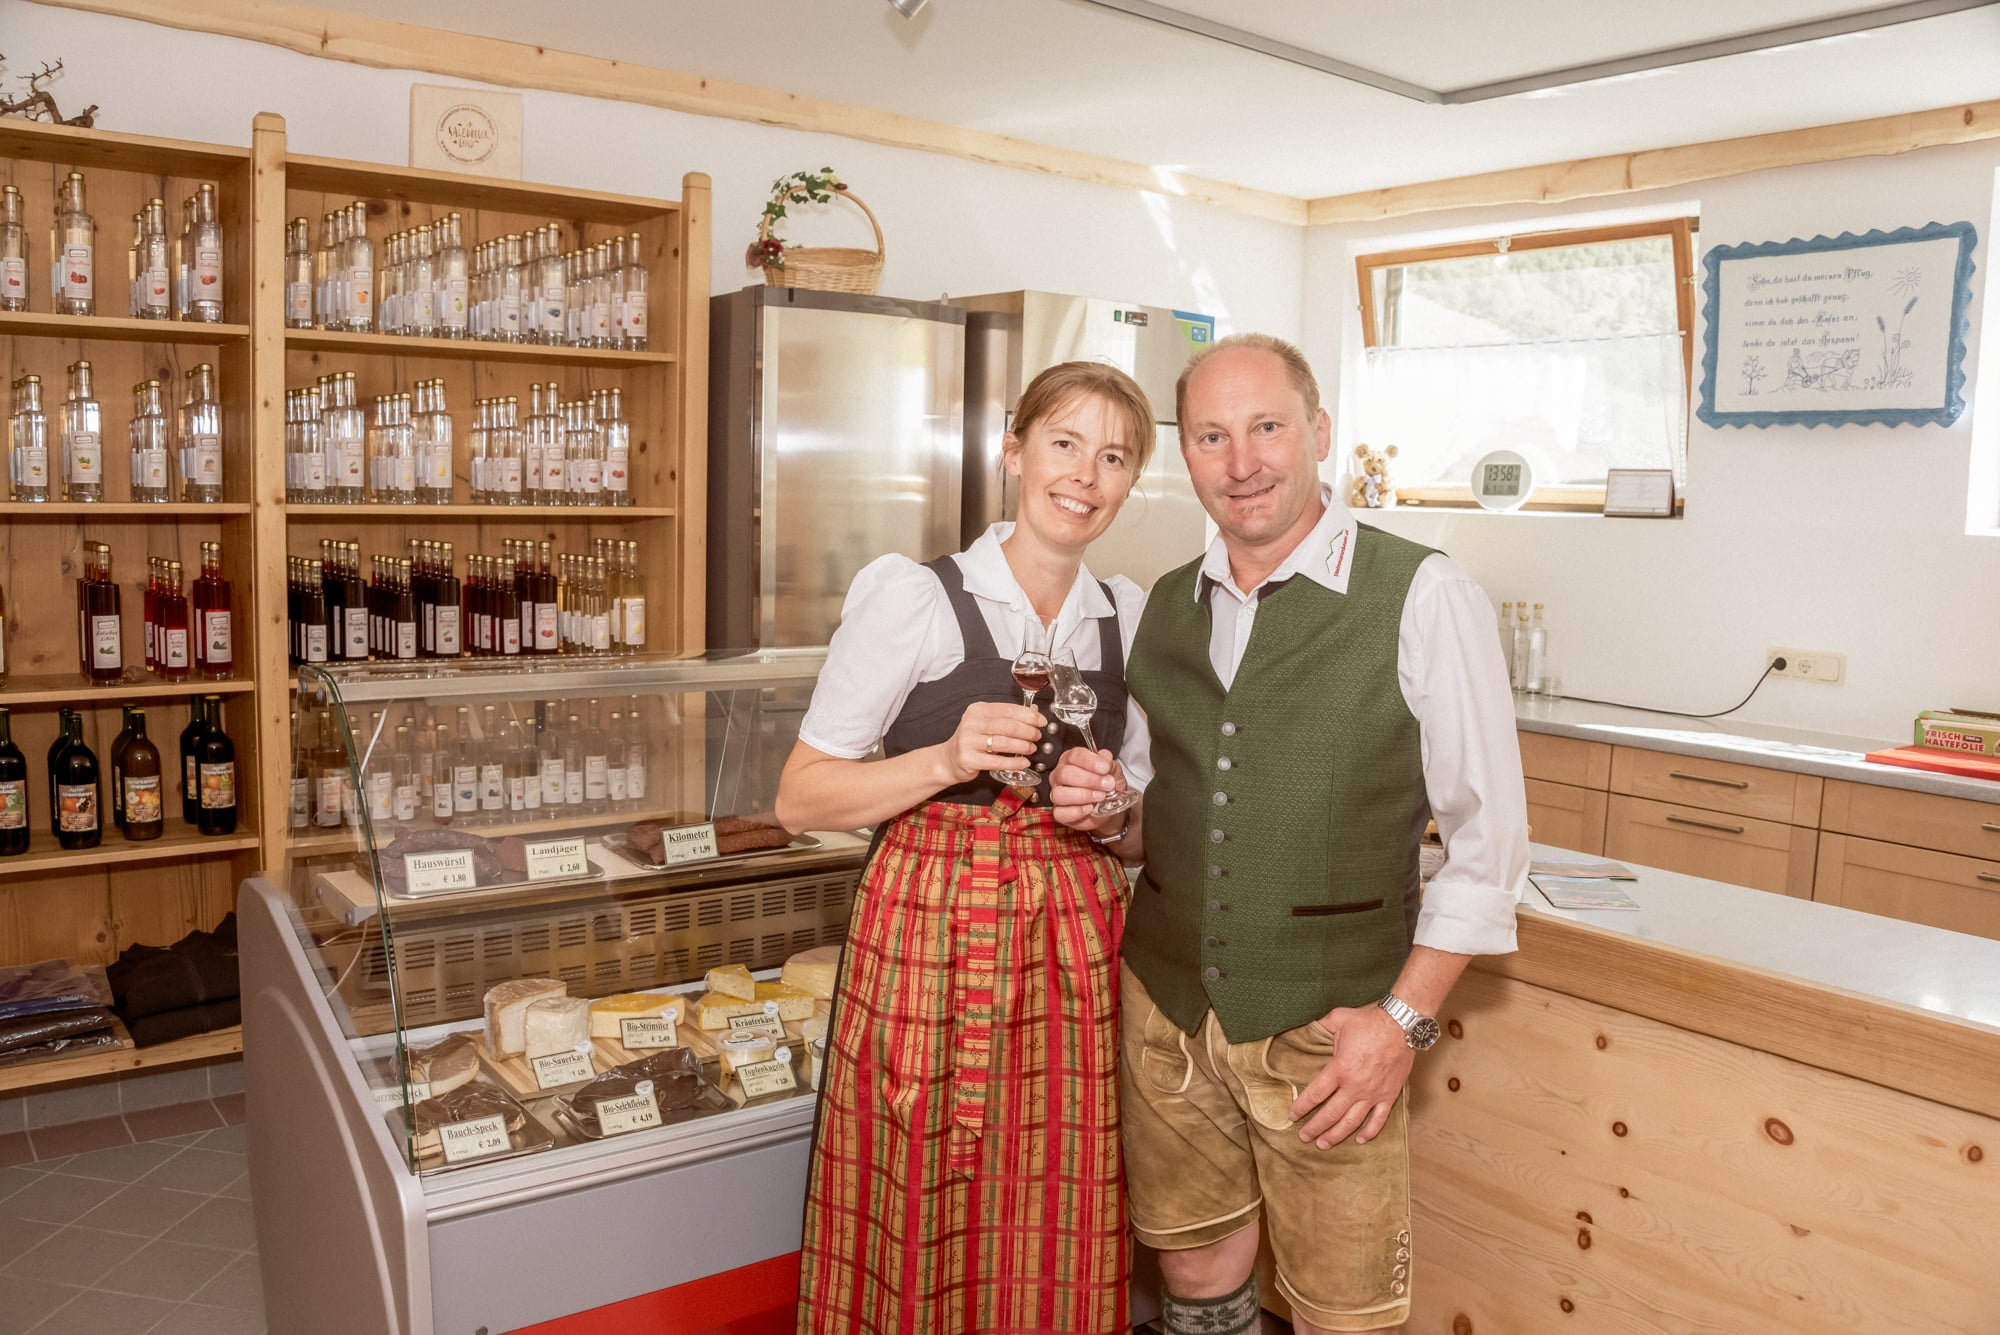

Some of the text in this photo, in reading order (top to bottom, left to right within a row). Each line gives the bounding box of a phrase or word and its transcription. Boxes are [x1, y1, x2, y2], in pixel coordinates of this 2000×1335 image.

[1803, 273, 1812, 281] du
[1925, 730, 1961, 741] FRISCH
[1925, 737, 1985, 752] HALTEFOLIE
[669, 830, 709, 843] Kilometer
[532, 844, 579, 856] Landjäger
[693, 846, 698, 854] €
[413, 856, 466, 870] Hauswürstl
[559, 864, 565, 872] €
[443, 873, 467, 883] € 1,80
[735, 1015, 775, 1028] Kräuterkäse
[744, 1062, 785, 1076] Topfenkugeln
[602, 1097, 650, 1114] Bio-Selchfleisch
[632, 1112, 653, 1124] € 4,19
[447, 1121, 499, 1140] Bauch-Speck
[478, 1137, 501, 1149] € 2,09
